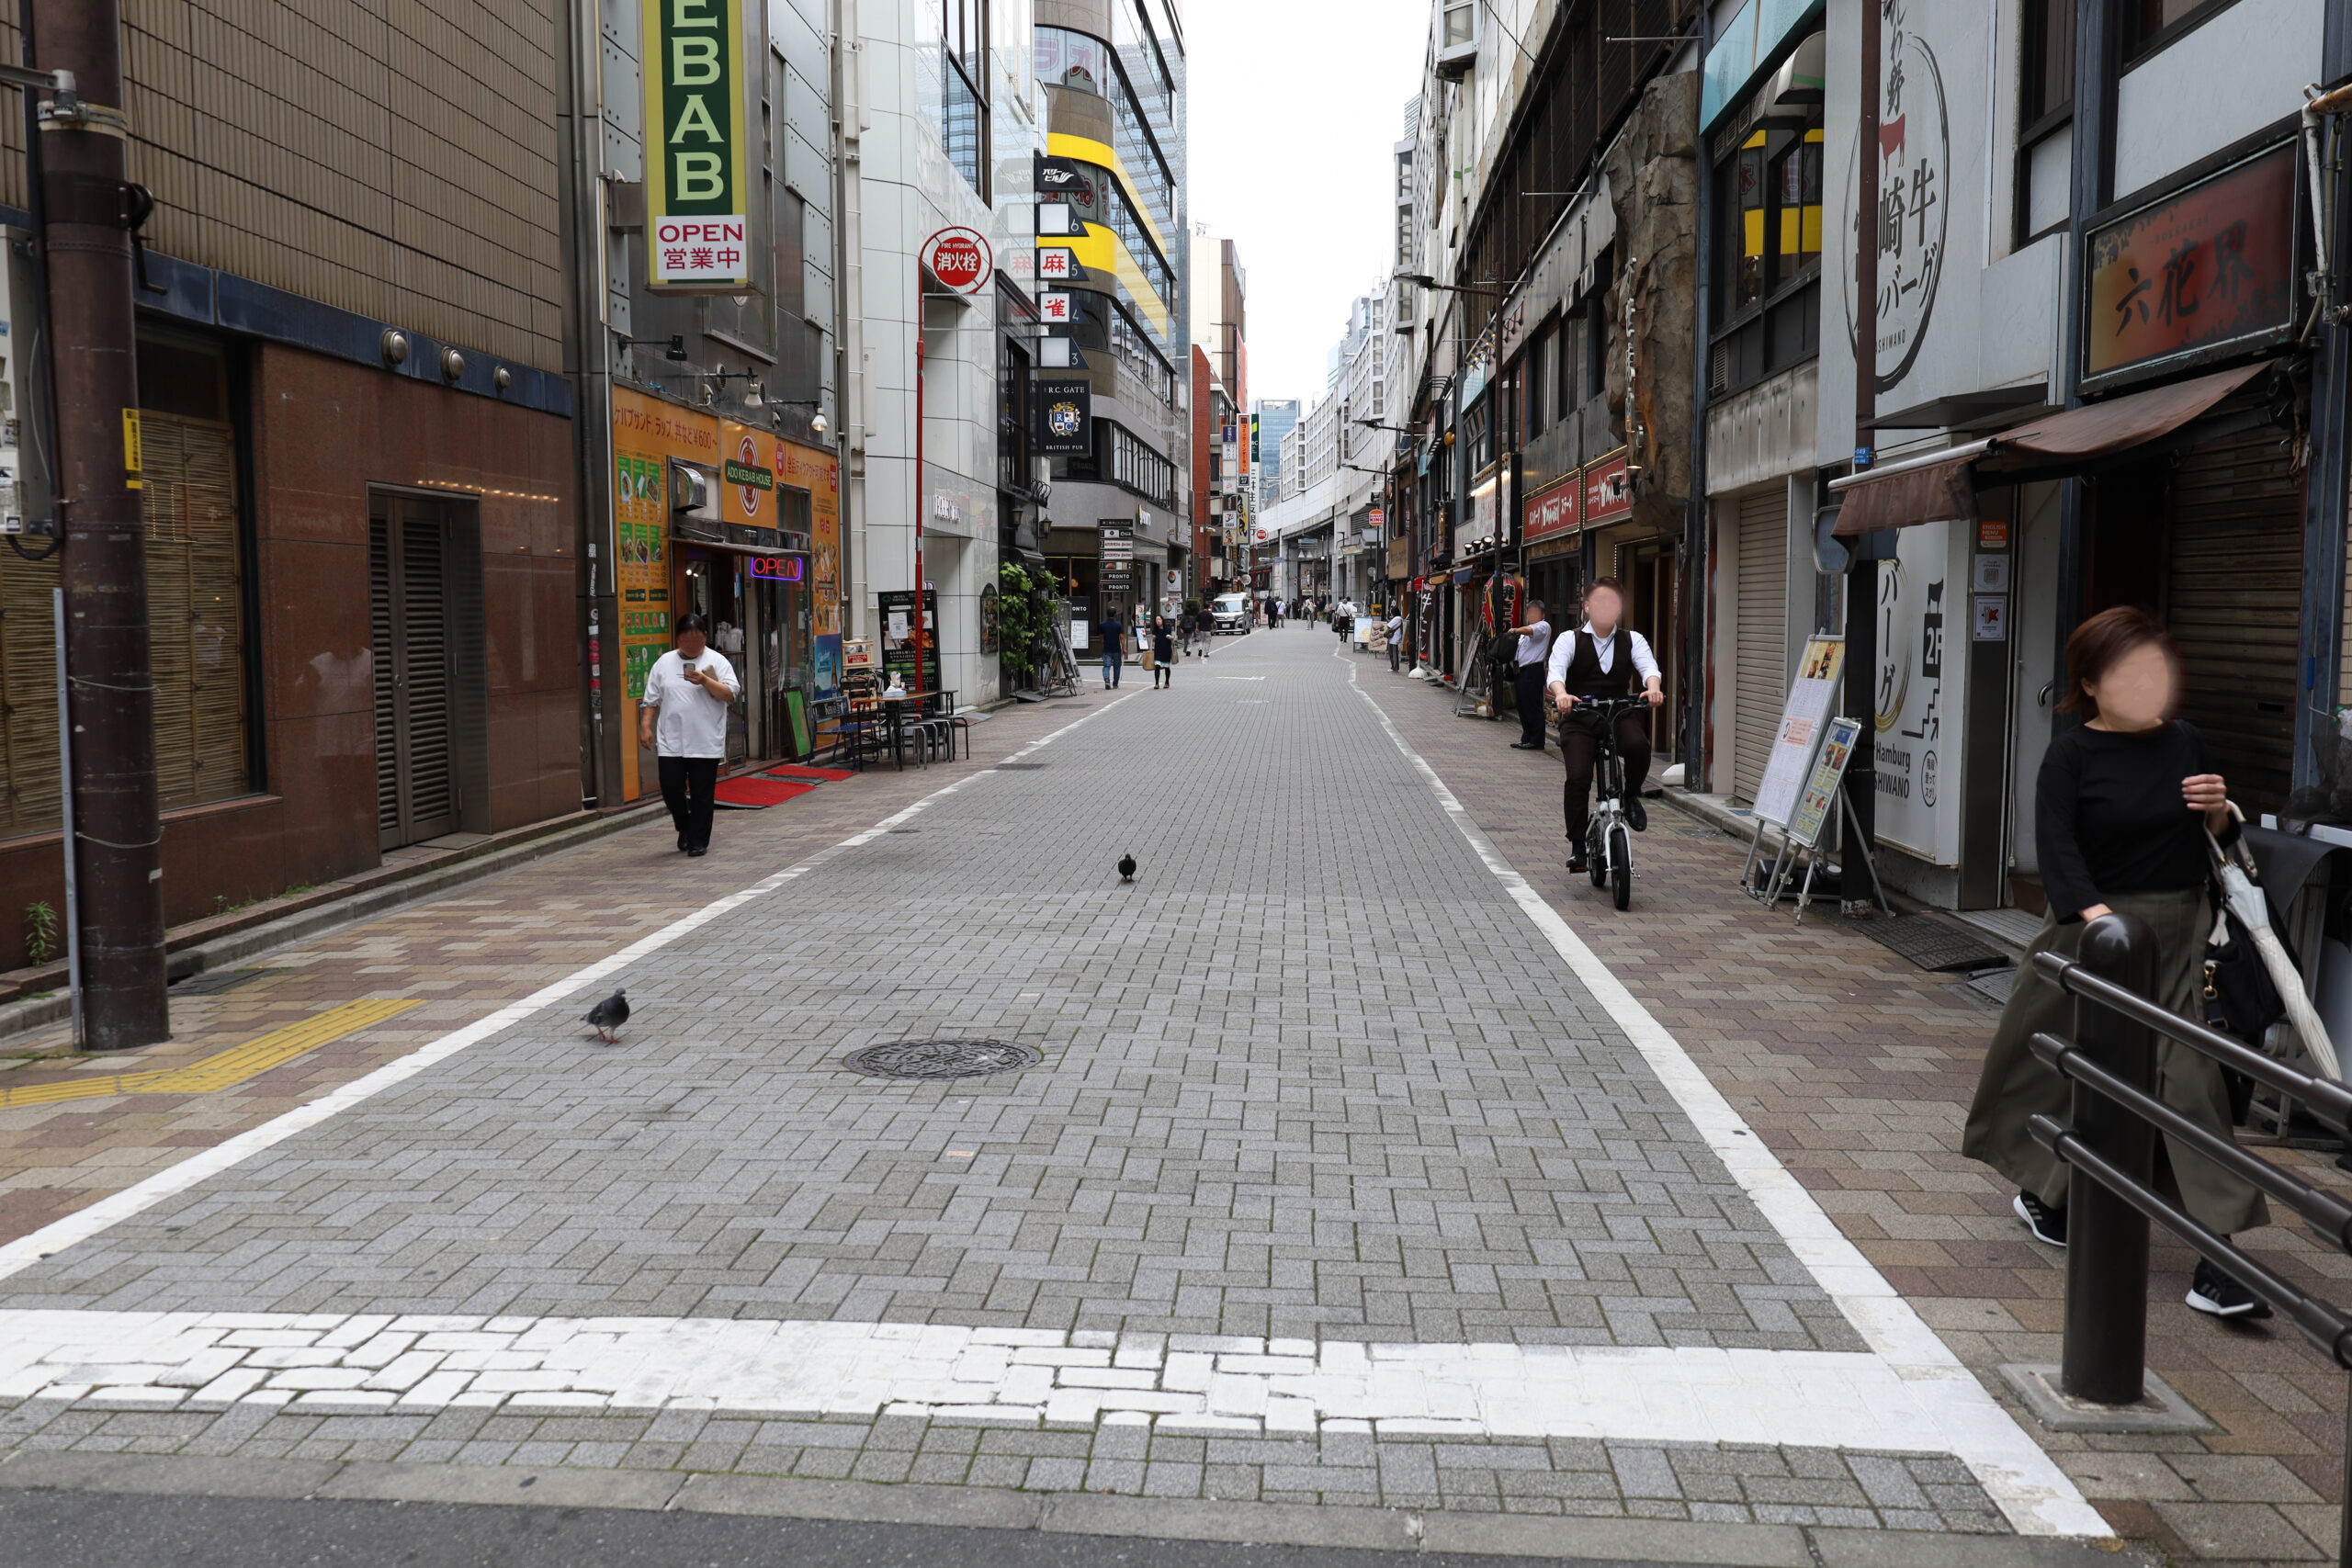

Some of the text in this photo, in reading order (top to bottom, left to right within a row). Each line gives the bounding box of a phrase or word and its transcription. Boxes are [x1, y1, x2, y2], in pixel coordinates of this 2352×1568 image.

[669, 0, 724, 201] EBAB
[1070, 219, 1079, 231] 6
[1854, 158, 1936, 283] 崎牛
[659, 223, 743, 242] OPEN
[663, 247, 741, 269] 営業中
[937, 252, 978, 272] 消火栓
[1043, 254, 1066, 273] 麻
[1071, 264, 1079, 276] 5
[2116, 219, 2256, 337] 六花界
[1045, 299, 1066, 317] 雀
[1072, 309, 1080, 321] 4
[1875, 329, 1906, 353] SHIWANO
[1071, 353, 1079, 366] 3
[1056, 413, 1063, 422] R
[1066, 423, 1072, 431] C
[727, 467, 772, 487] ADO KEBAB HOUSE
[753, 558, 799, 578] OPEN
[1876, 741, 1911, 773] Hamburg
[1873, 772, 1910, 799] SHIWANO
